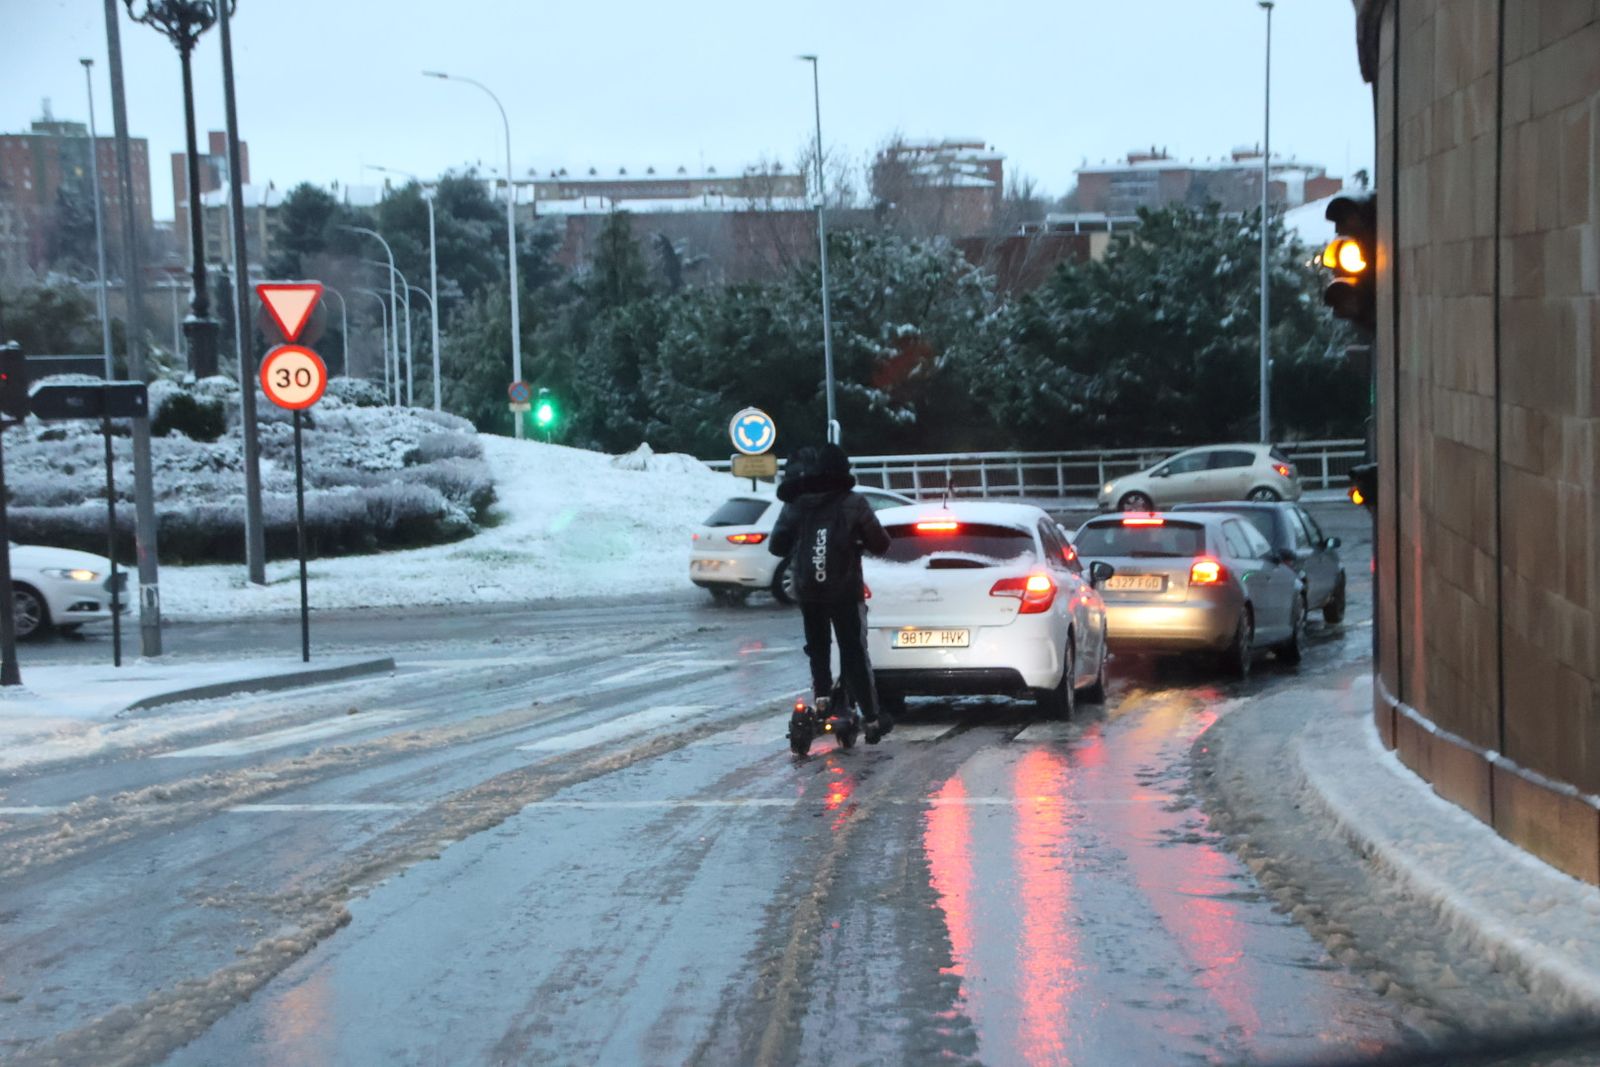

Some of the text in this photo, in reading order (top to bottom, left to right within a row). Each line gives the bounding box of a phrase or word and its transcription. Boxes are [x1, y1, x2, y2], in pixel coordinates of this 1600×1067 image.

[275, 367, 311, 388] 30
[812, 528, 827, 582] adidas
[901, 631, 964, 645] 9817 HVK
